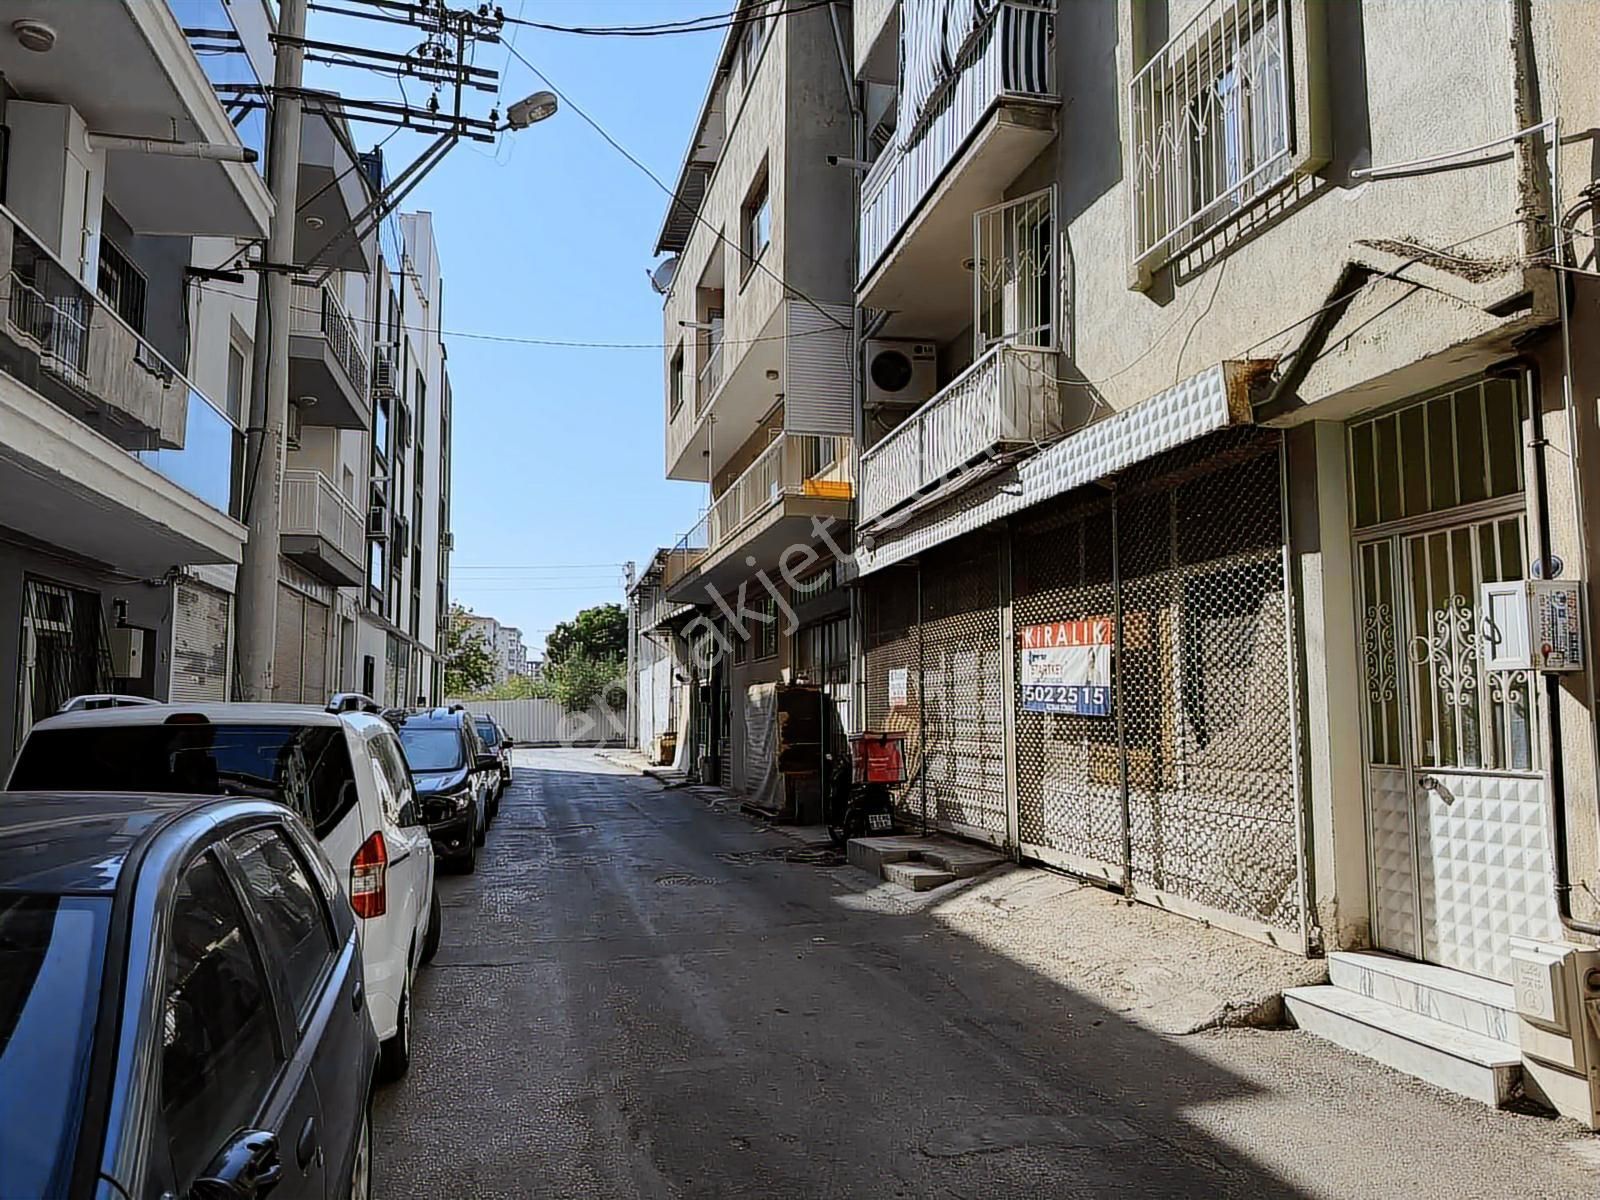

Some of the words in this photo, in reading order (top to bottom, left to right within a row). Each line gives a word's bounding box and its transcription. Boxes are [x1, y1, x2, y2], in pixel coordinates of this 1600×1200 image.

[1025, 686, 1054, 702] 502
[1056, 687, 1078, 704] 25
[1082, 687, 1104, 705] 15
